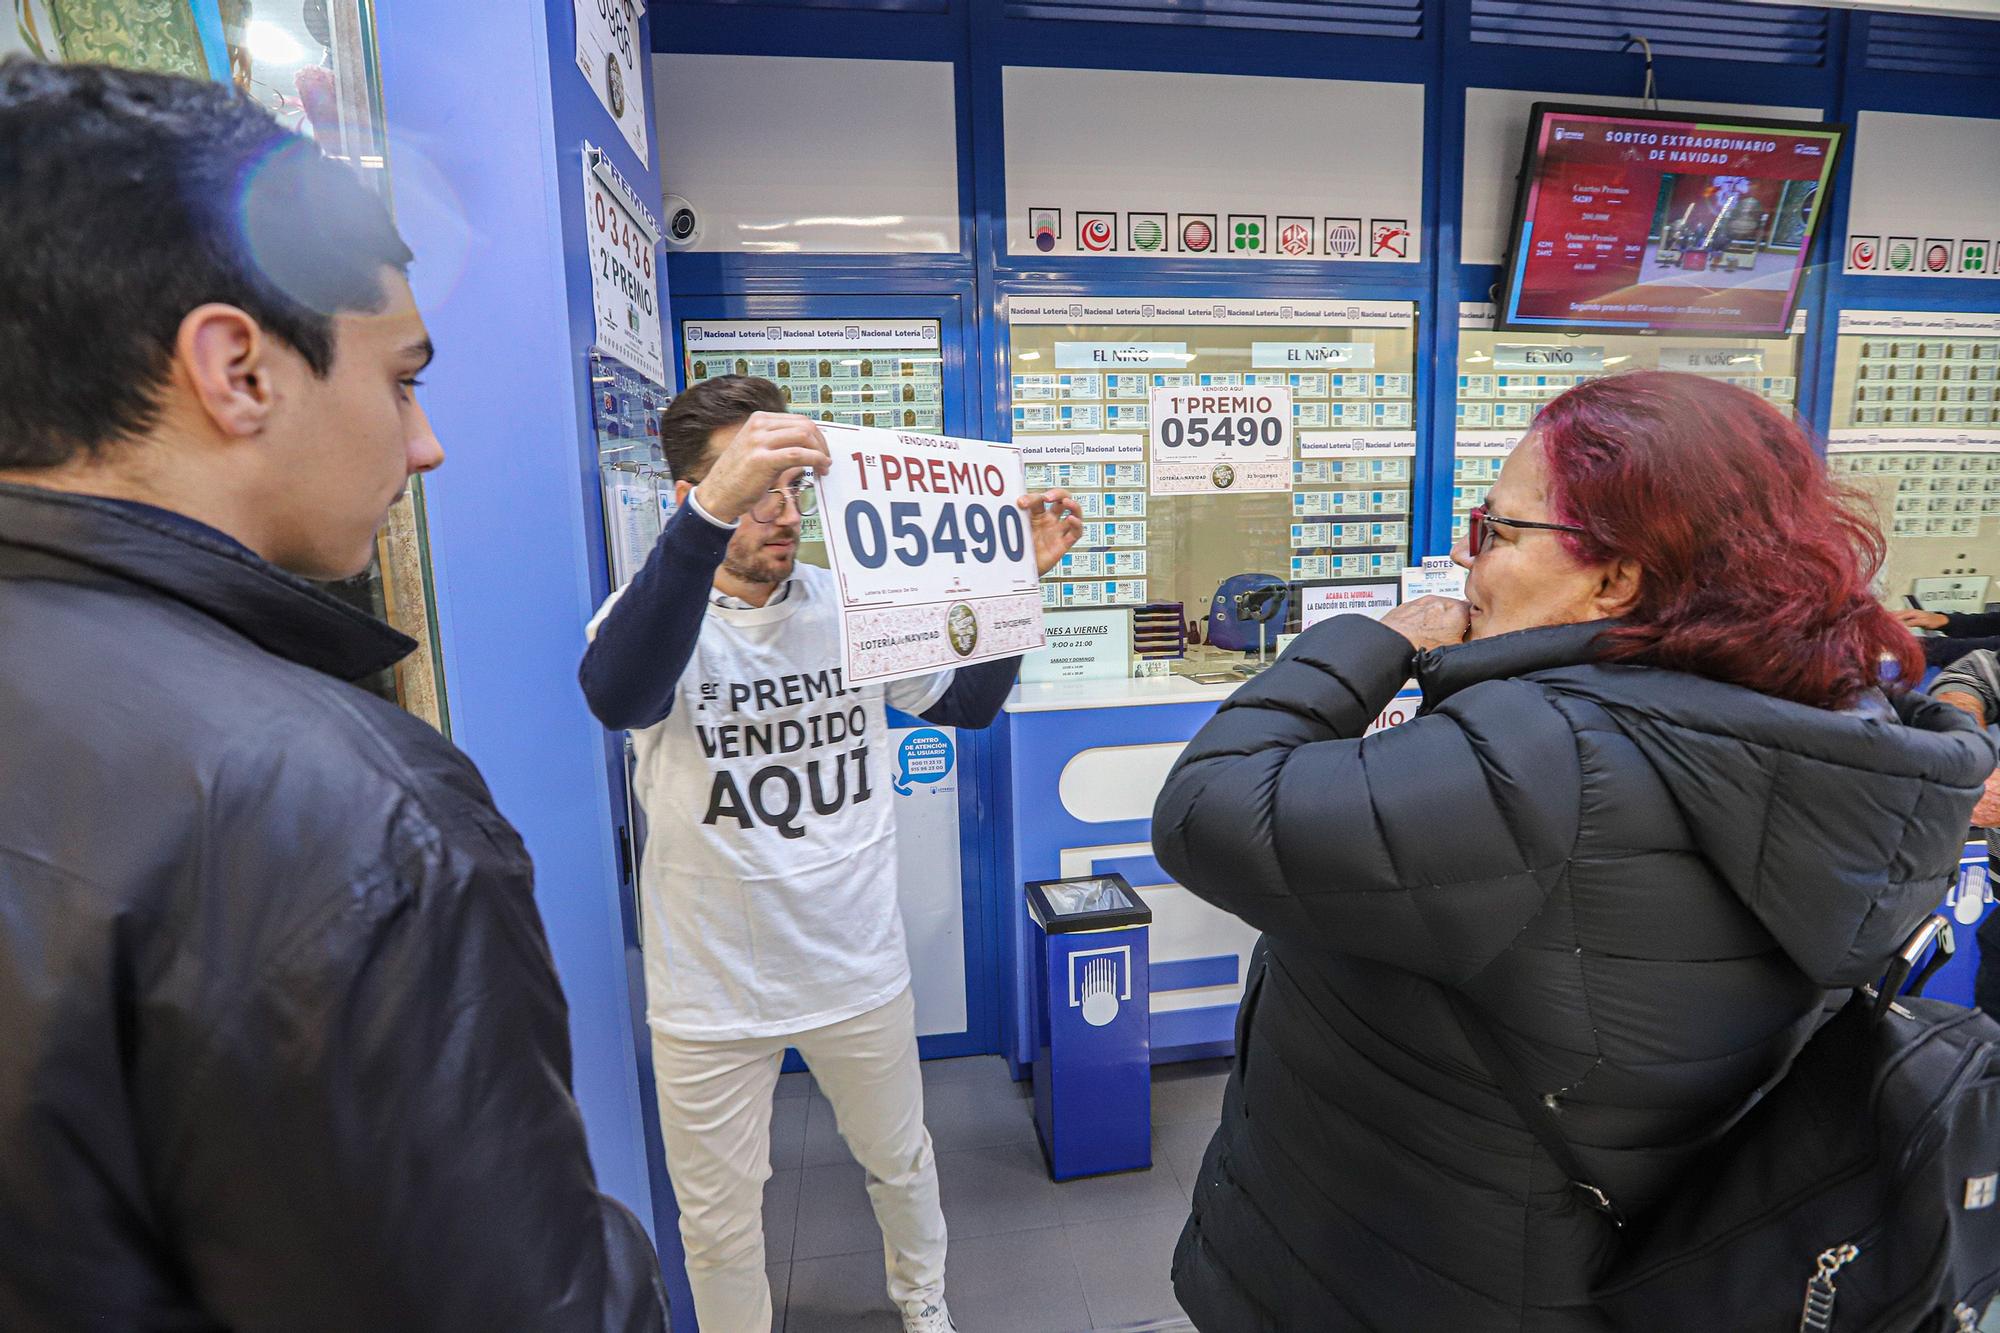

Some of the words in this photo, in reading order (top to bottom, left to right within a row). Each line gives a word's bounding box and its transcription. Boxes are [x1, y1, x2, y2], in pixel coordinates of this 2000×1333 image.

[1606, 131, 1658, 145] SORTEO
[1661, 134, 1776, 152] EXTRAORDINARIO
[1648, 150, 1666, 160] DE
[1670, 150, 1728, 164] NAVIDAD
[596, 192, 650, 279] 03436
[612, 256, 652, 316] PREMIO
[1094, 350, 1108, 362] EL
[1112, 348, 1149, 362] NIÑO
[1288, 349, 1300, 360] EL
[1306, 346, 1340, 361] NIÑO
[1544, 350, 1574, 364] NIÑO
[1188, 396, 1272, 414] PREMIO
[898, 435, 938, 448] VENDIDO
[1162, 417, 1282, 447] 05490
[880, 454, 1004, 496] PREMIO
[844, 500, 1024, 569] 05490
[905, 630, 940, 642] NAVIDAD
[1074, 626, 1108, 634] VIERNES
[696, 705, 866, 760] VENDIDO
[702, 738, 872, 839] AQUÍ
